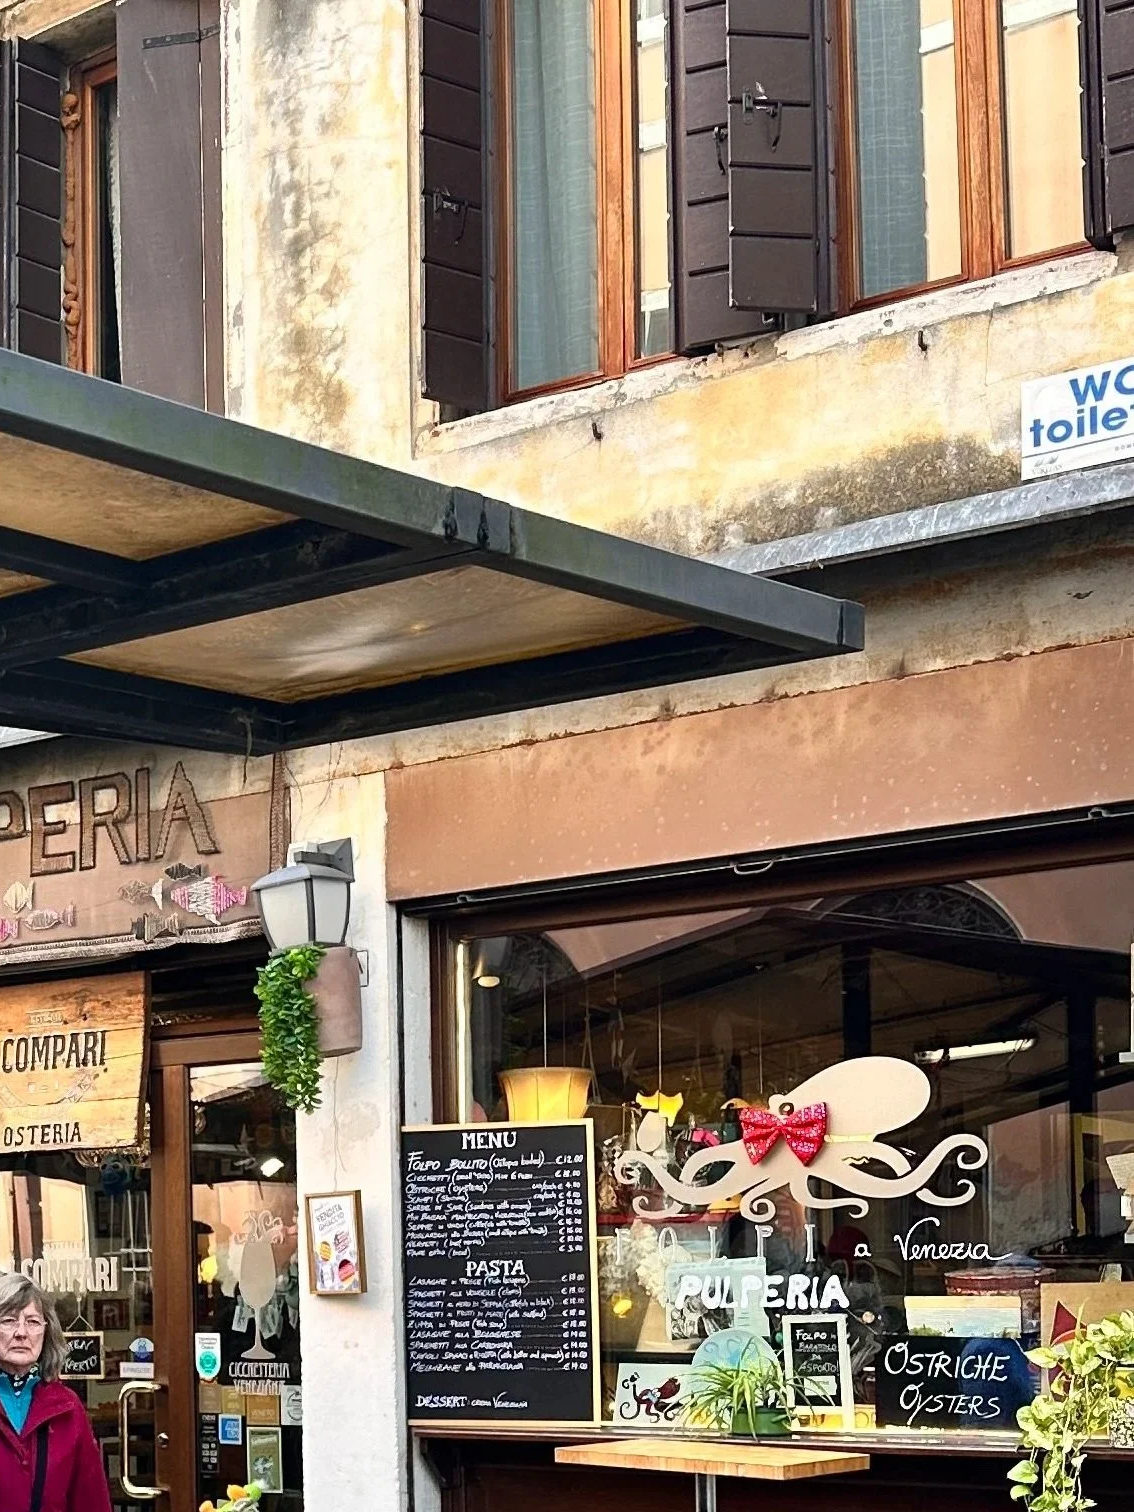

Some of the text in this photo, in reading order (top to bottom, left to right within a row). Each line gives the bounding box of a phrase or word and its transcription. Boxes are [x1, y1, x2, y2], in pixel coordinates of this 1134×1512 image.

[1029, 404, 1134, 447] toile
[1, 1031, 107, 1074] COMPARI
[3, 1121, 82, 1147] OSTERIA
[461, 1131, 517, 1150] MENU
[407, 1151, 441, 1172] FOLPO
[445, 1158, 488, 1171] BOLLITO
[894, 1217, 1013, 1261] Venezia
[465, 1259, 527, 1277] PASTA
[675, 1273, 850, 1311] PULPERIA
[66, 1339, 94, 1353] PEN
[795, 1329, 827, 1341] FOLPO
[884, 1341, 1010, 1383] OSTRICHE
[899, 1382, 1001, 1426] OYSTERS
